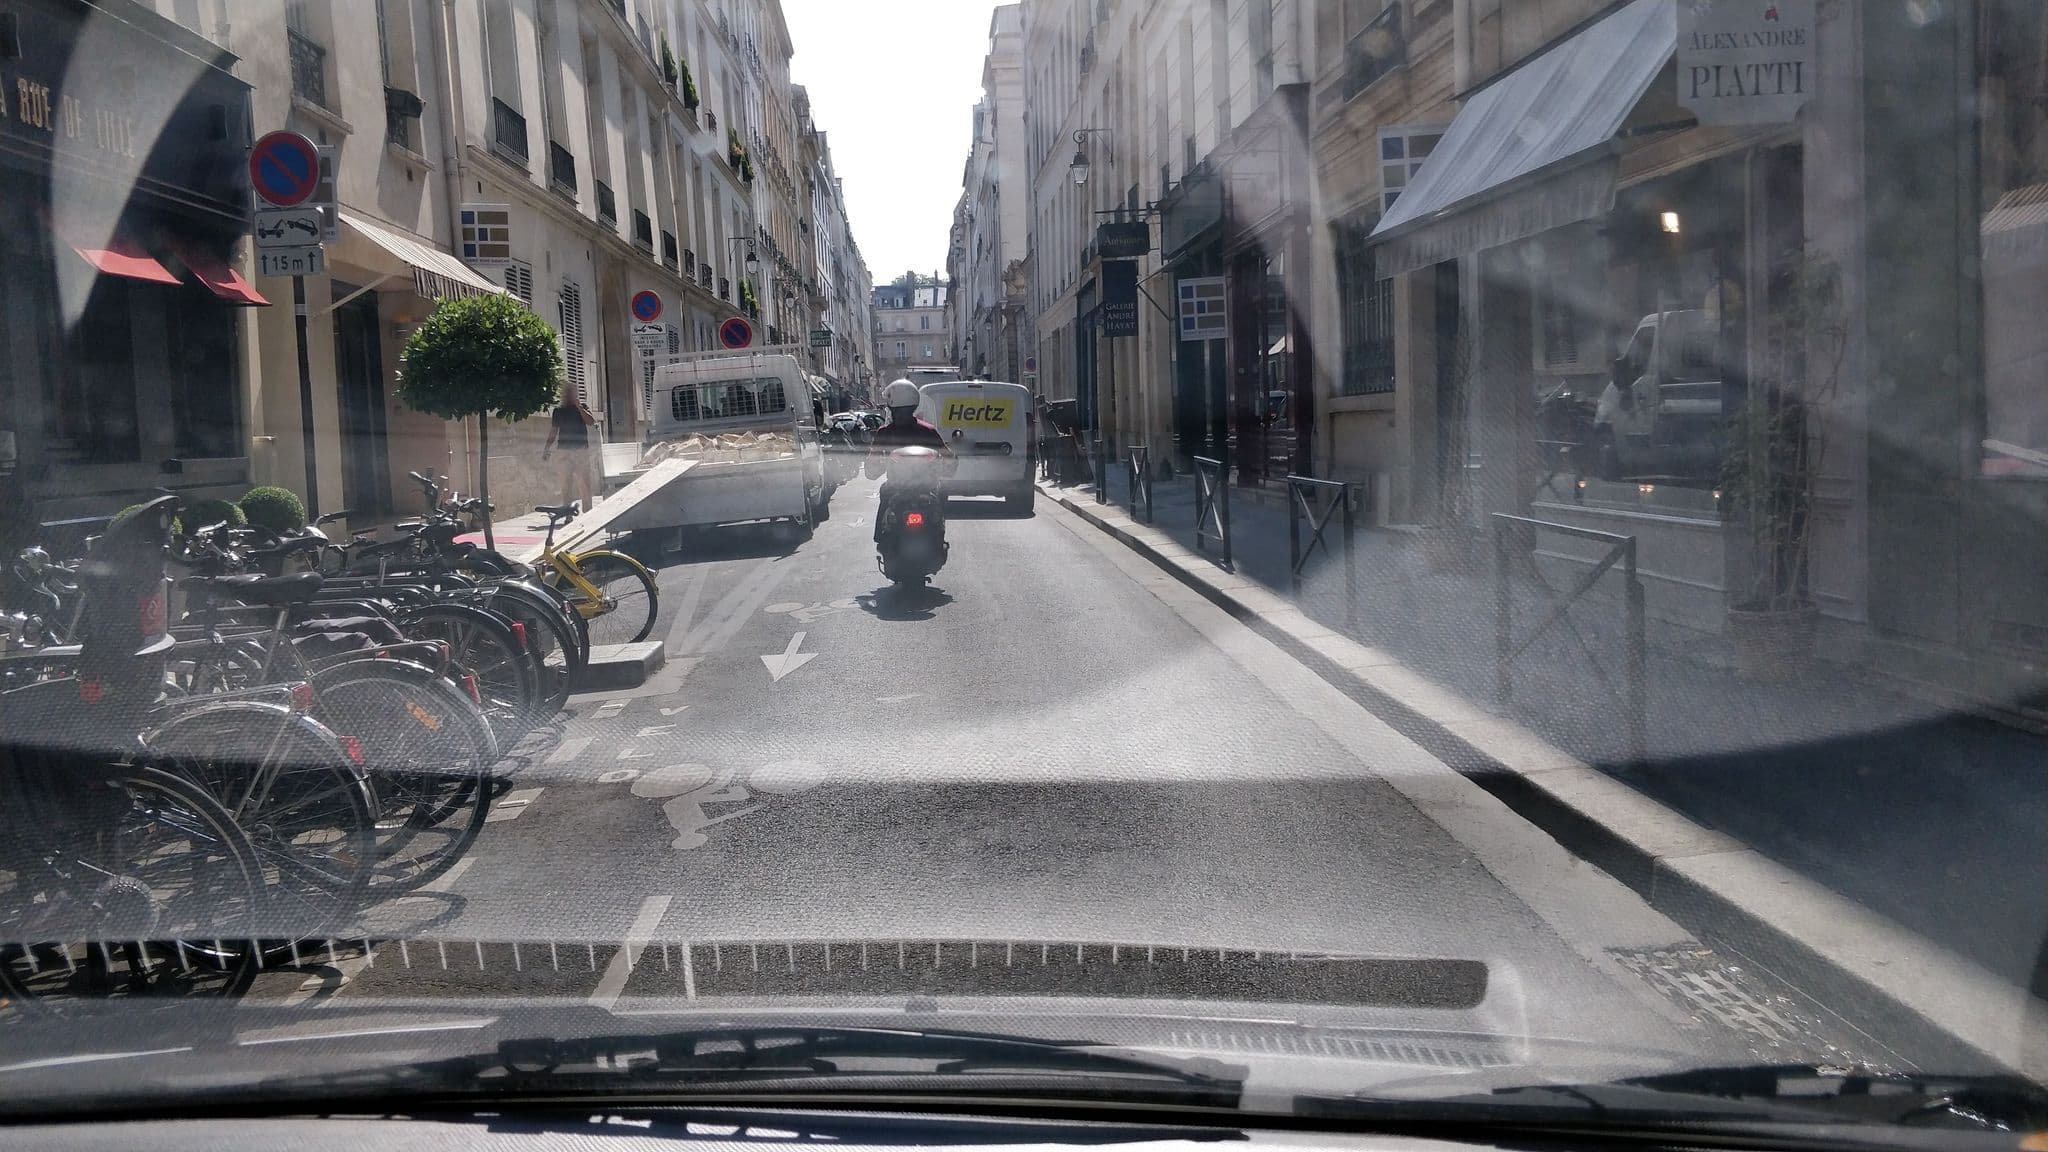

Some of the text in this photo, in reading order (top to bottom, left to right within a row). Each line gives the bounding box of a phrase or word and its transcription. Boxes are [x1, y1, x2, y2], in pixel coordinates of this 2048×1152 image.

[1688, 28, 1806, 50] ALEXANDRE
[1688, 61, 1804, 99] PIATTI
[273, 255, 304, 270] 15 m
[948, 403, 1005, 422] Hertz
